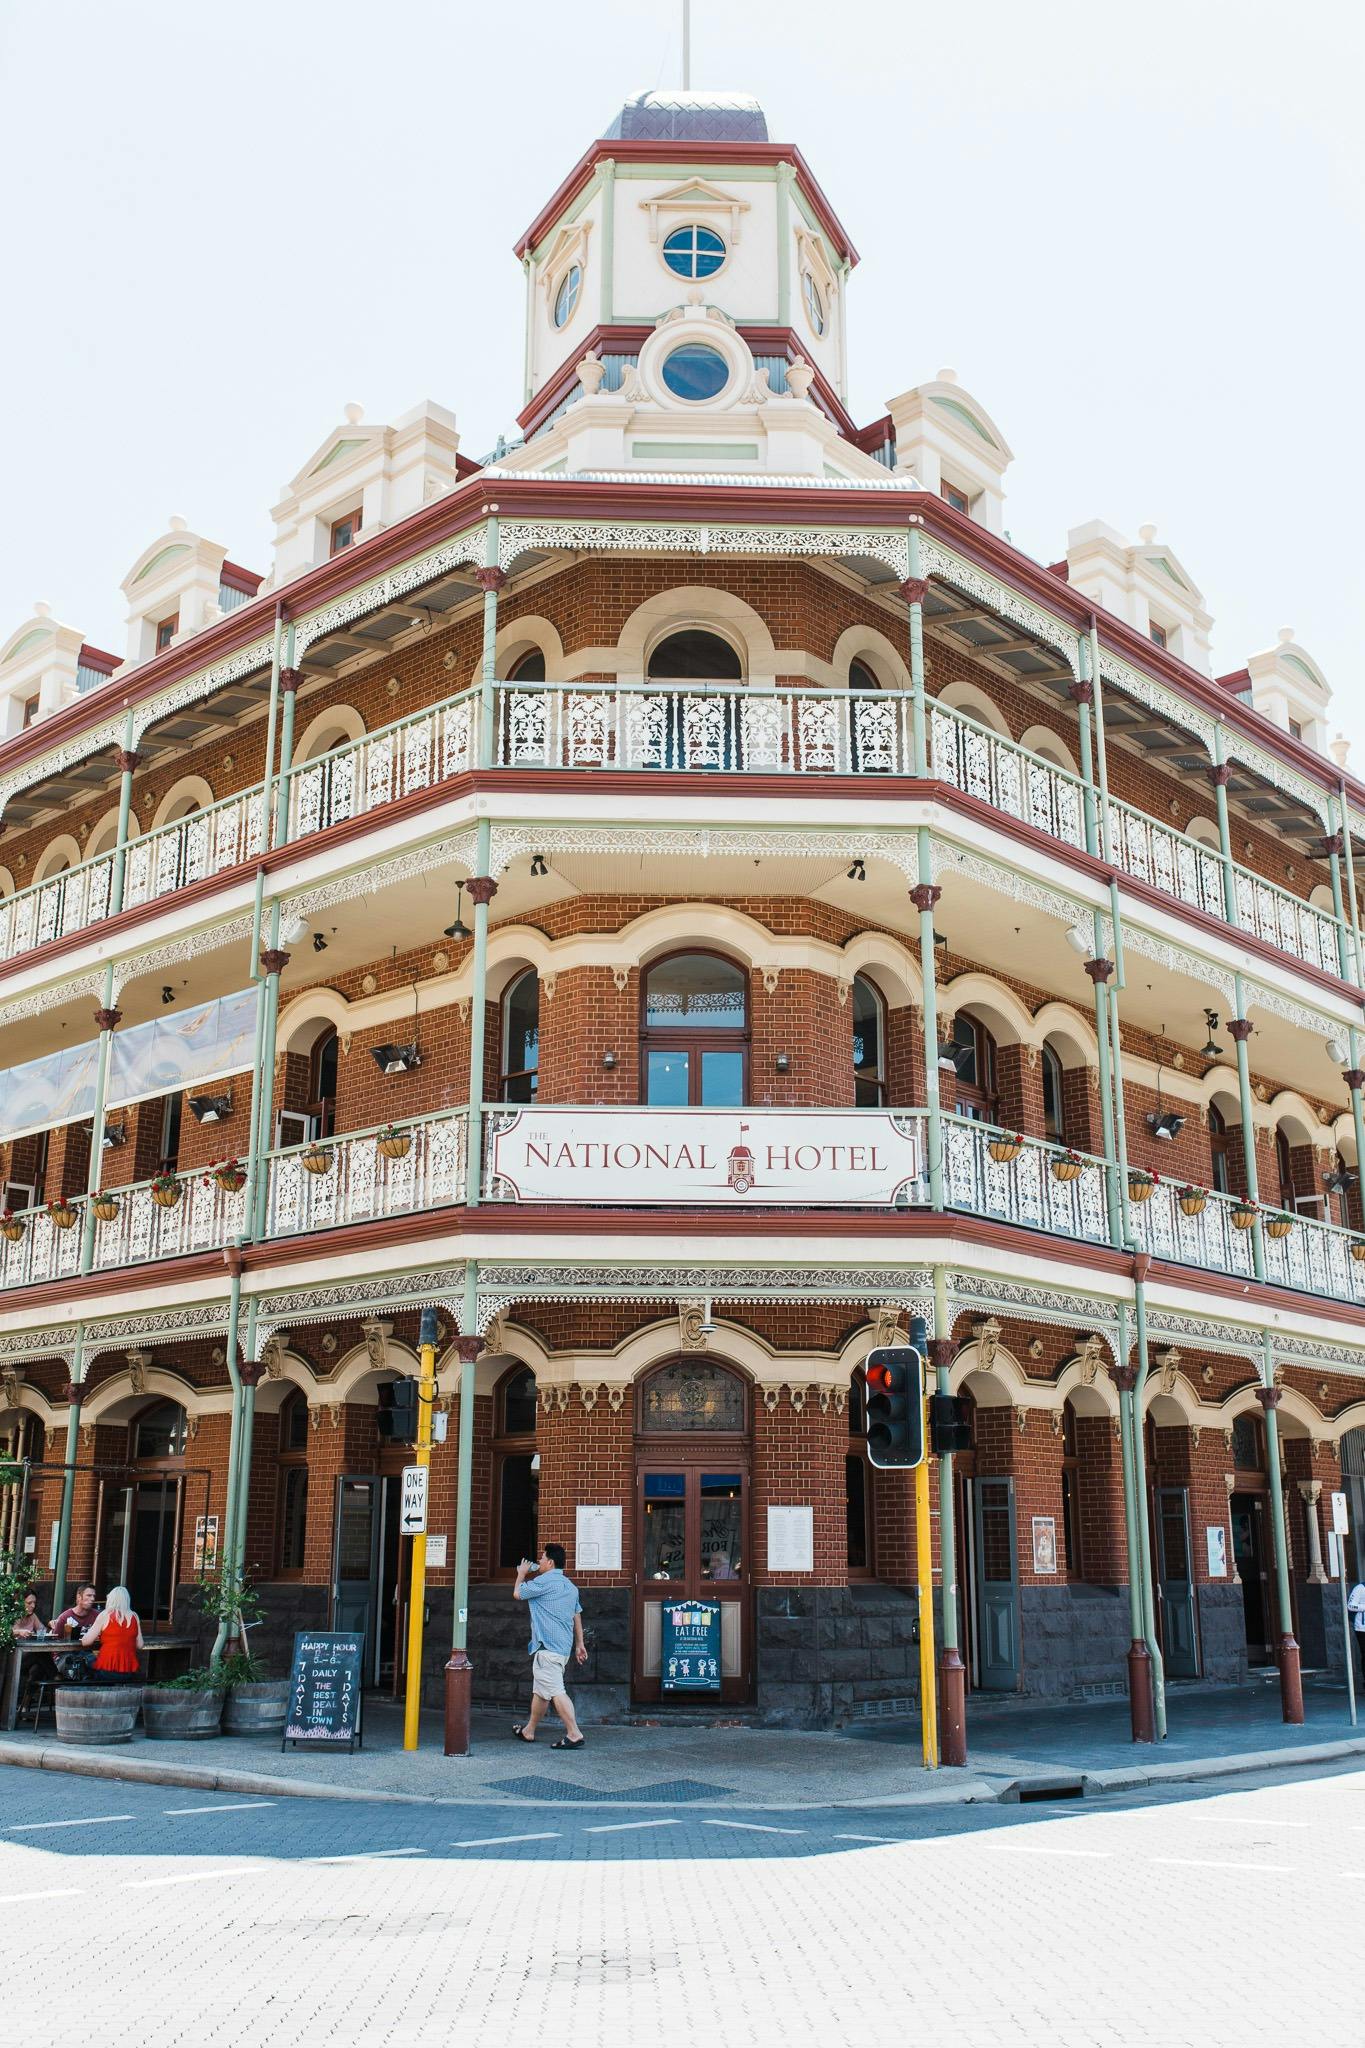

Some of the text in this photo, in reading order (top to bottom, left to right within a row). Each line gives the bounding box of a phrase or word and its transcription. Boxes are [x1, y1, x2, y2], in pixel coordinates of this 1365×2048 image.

[528, 1131, 549, 1140] THE
[524, 1142, 888, 1171] NATIONAL HOTEL
[406, 1473, 424, 1488] ONE
[404, 1493, 424, 1509] WAY
[675, 1626, 708, 1637] EAT FREE
[301, 1642, 357, 1652] HAPPY HOUR
[312, 1669, 338, 1678] DAILY
[295, 1661, 307, 1716] 7 DAYS
[314, 1682, 332, 1690] THE
[313, 1691, 337, 1699] BEST
[341, 1670, 352, 1724] 7 DAYS
[312, 1700, 337, 1709] DEAL
[312, 1709, 323, 1717] IN
[306, 1716, 333, 1725] TOWN
